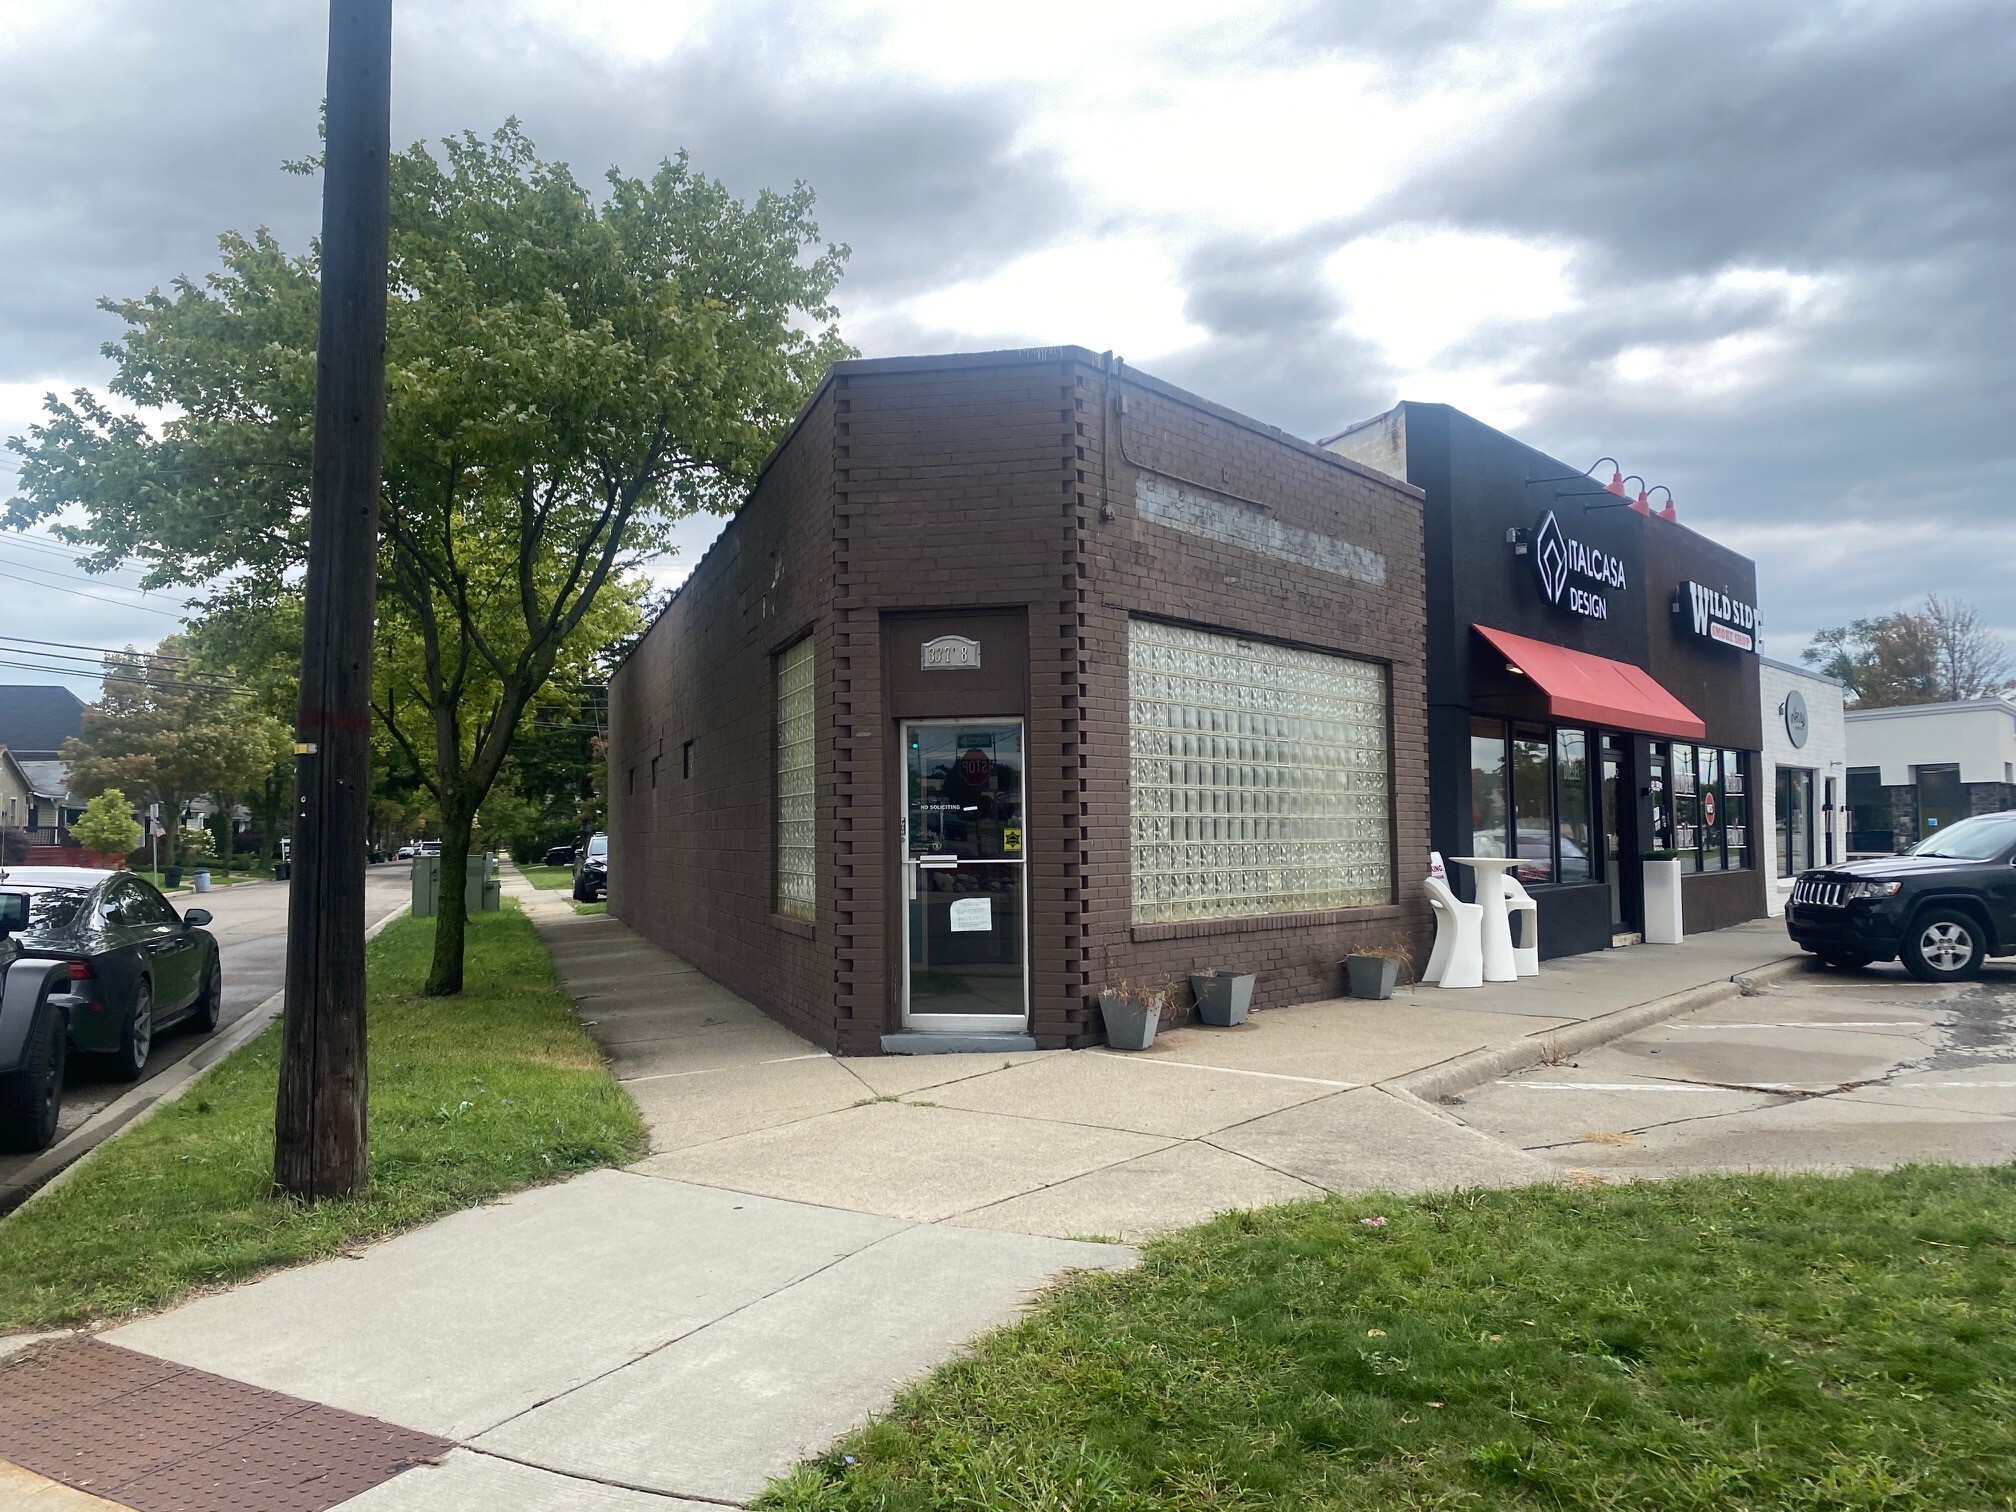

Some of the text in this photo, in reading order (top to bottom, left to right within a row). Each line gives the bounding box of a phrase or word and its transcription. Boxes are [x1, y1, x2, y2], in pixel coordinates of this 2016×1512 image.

[1568, 538, 1627, 590] ITALCASA
[1569, 586, 1607, 620] DESIGN
[1689, 580, 1765, 656] WILD SIDE
[1711, 624, 1751, 648] SMOKE SHOP
